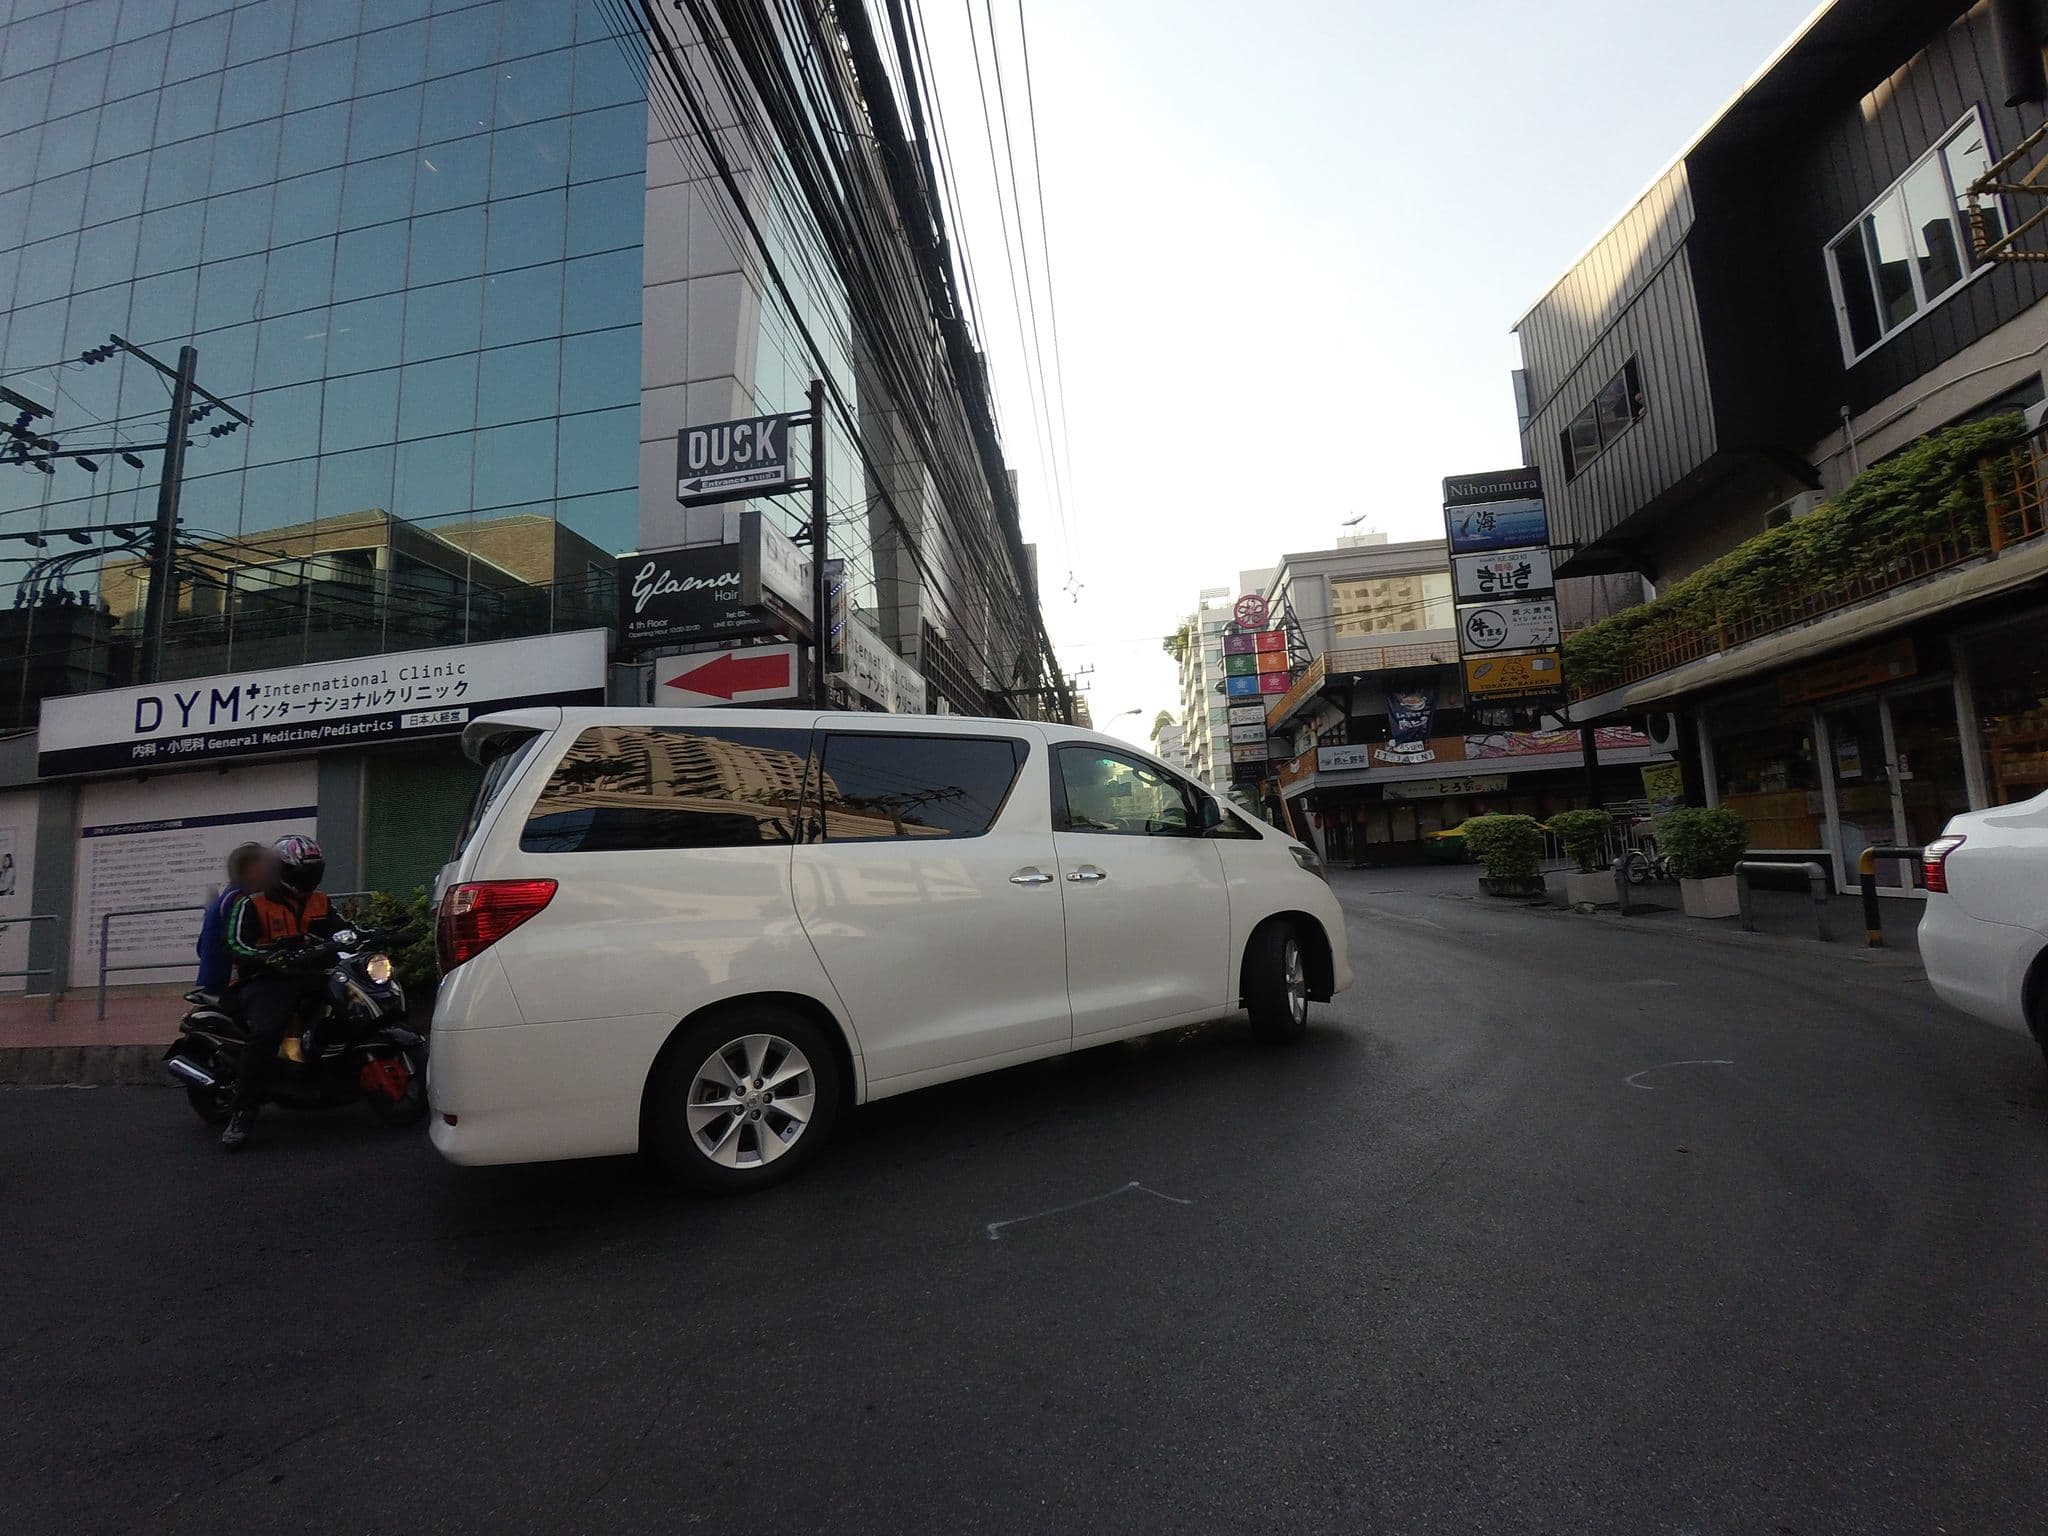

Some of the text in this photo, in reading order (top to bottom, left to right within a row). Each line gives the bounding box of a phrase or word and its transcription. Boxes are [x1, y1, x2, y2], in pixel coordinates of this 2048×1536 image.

[689, 420, 777, 469] DUSK
[702, 478, 746, 488] Entrance
[1450, 480, 1537, 497] Nihonmura
[1477, 511, 1496, 532] 海
[715, 590, 738, 601] Hair
[636, 621, 645, 629] th
[647, 618, 669, 628] Floor
[263, 662, 466, 697] International Clinic
[135, 686, 240, 734] DYM
[246, 680, 469, 720] インターナショナルクリニック
[208, 720, 394, 750] General Medicine/Pediatrics
[132, 737, 205, 758] 内科・小児科
